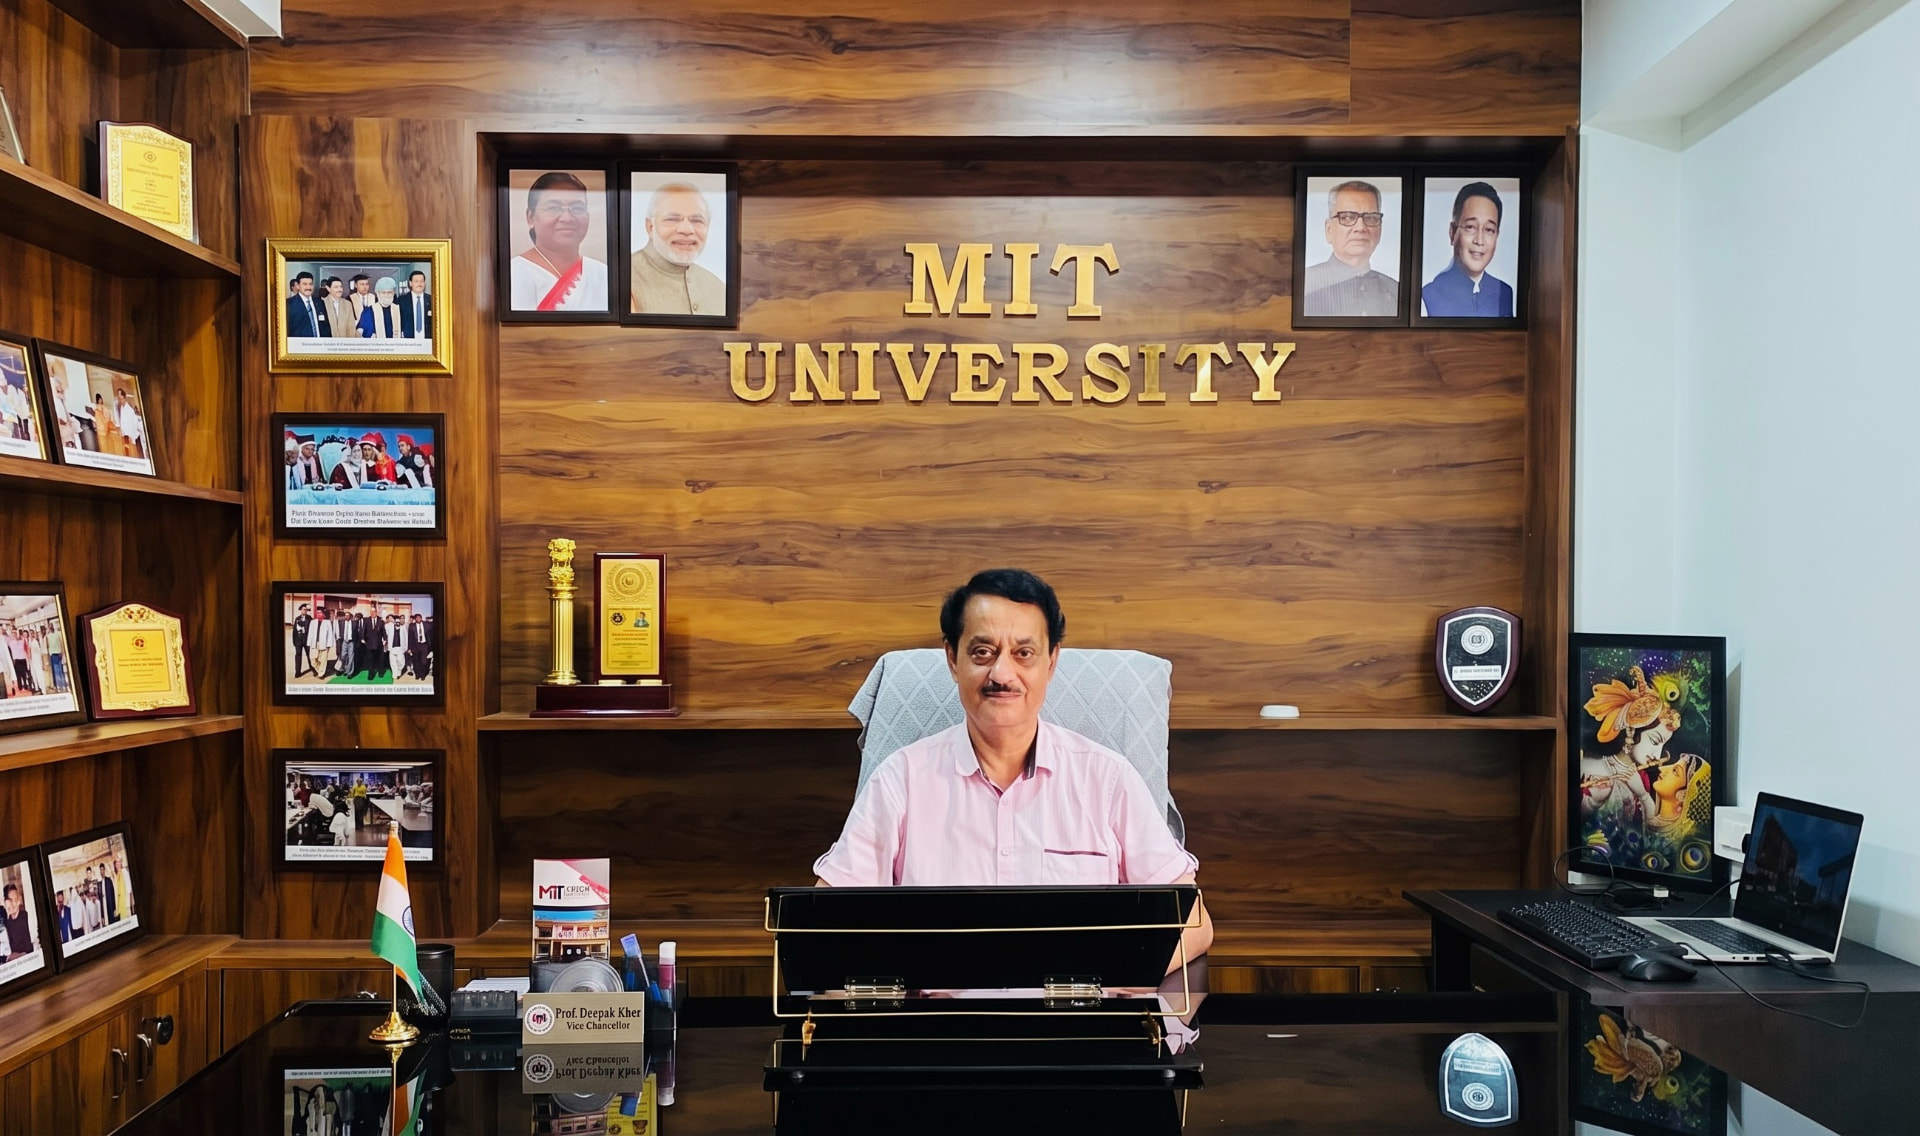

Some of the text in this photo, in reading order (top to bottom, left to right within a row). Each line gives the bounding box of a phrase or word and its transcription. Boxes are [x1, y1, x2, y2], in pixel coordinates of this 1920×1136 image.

[904, 242, 1119, 318] MIT
[722, 341, 1296, 404] UNIVERSITY
[538, 885, 565, 900] MIT
[555, 1007, 578, 1019] Prof.
[580, 1006, 615, 1021] Deepak
[618, 1007, 641, 1018] Kher
[566, 1021, 630, 1030] Vice Chancellor
